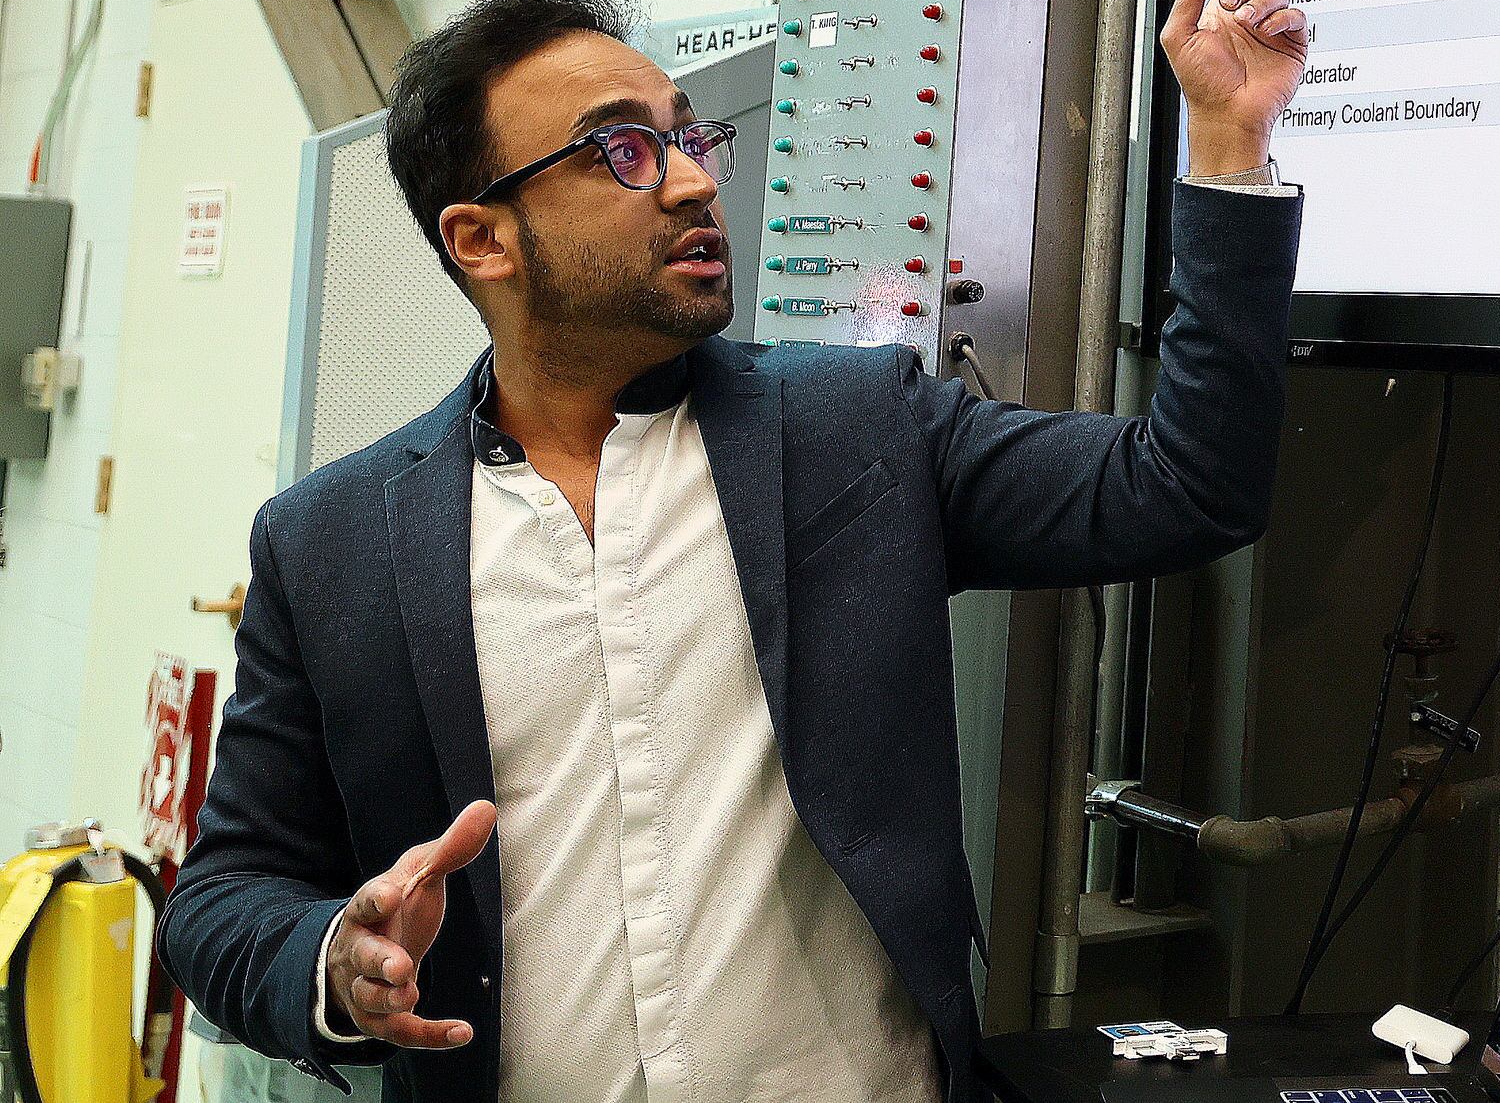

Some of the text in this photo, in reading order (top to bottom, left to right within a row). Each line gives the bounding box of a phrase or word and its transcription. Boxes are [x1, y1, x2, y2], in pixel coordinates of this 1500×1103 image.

[1282, 97, 1480, 130] Primary Coolant Boundary
